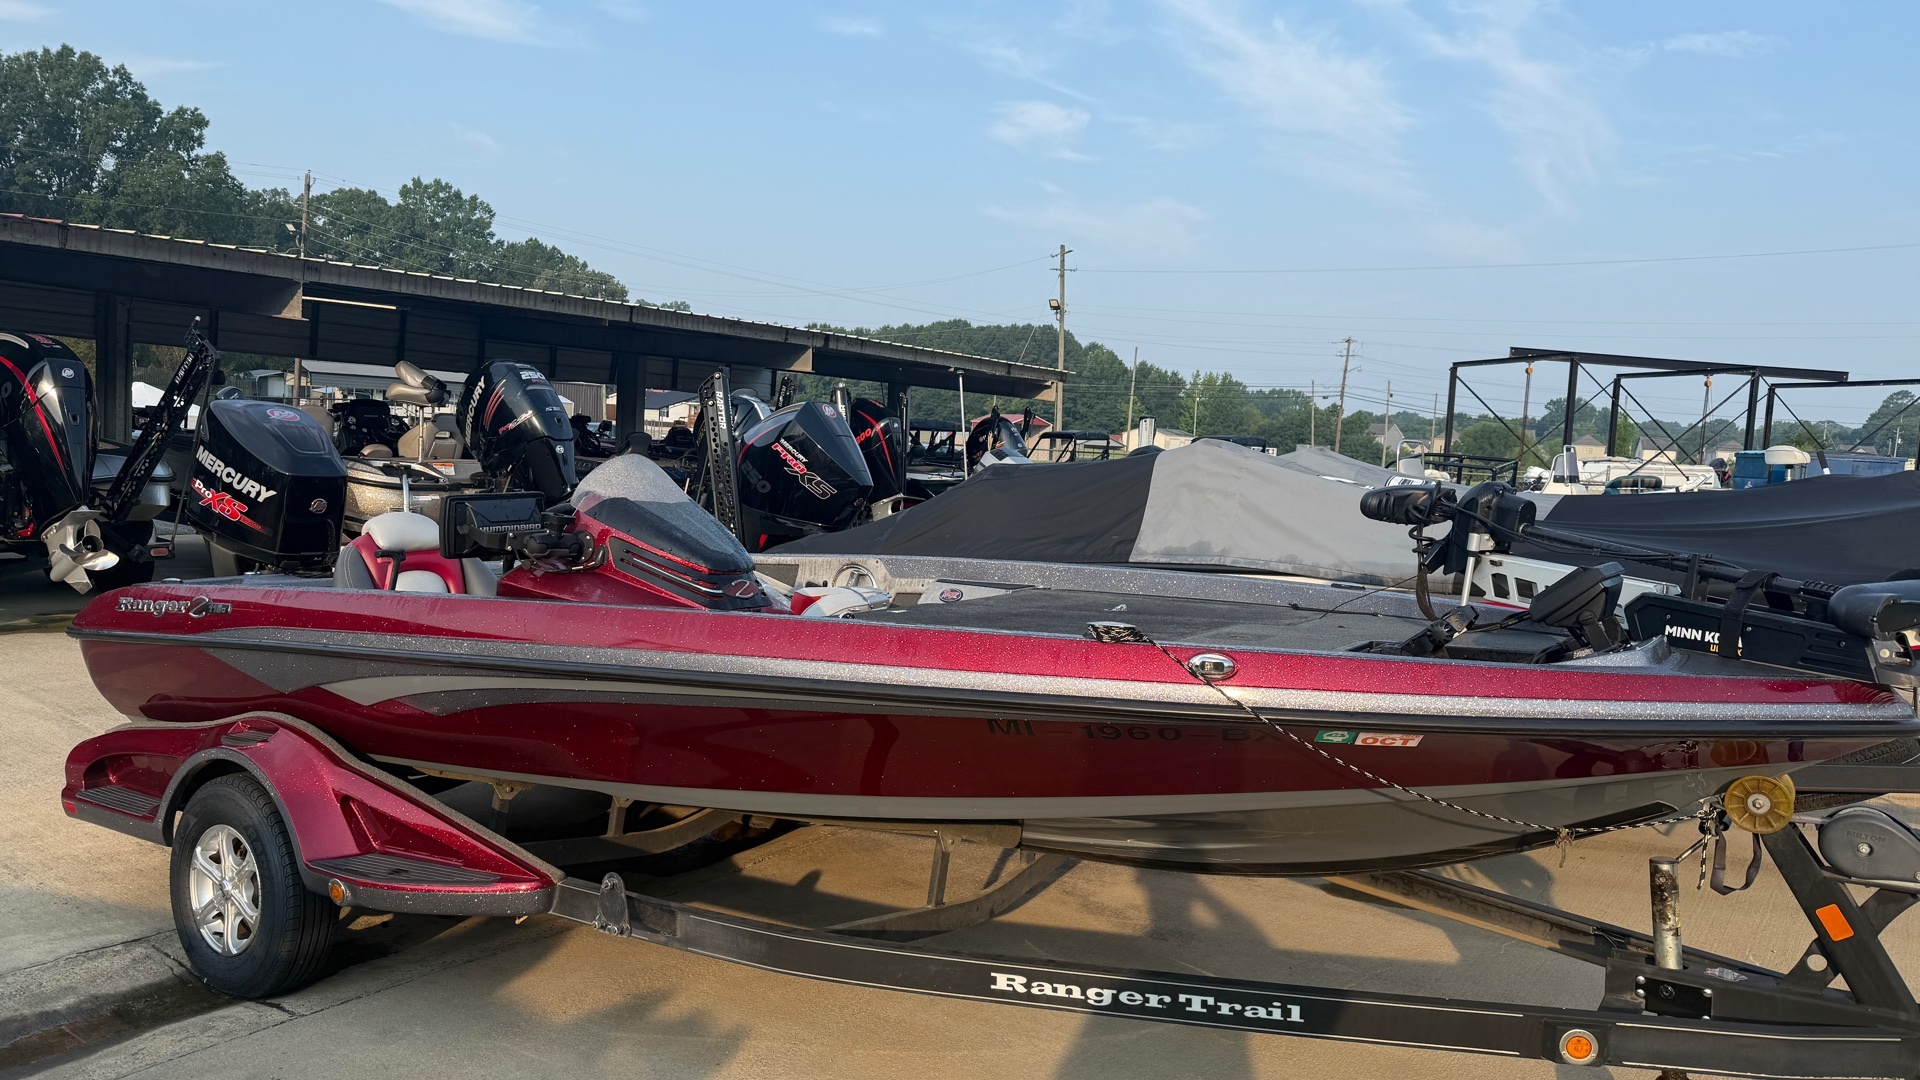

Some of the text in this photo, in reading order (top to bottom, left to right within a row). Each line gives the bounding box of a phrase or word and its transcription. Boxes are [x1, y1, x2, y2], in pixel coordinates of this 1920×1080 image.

[520, 371, 546, 380] 250
[465, 375, 486, 447] MERCURY
[715, 391, 727, 430] RAPTOR
[781, 438, 808, 462] MERCURY
[196, 444, 277, 503] MERCURY
[741, 460, 772, 494] 250
[783, 467, 838, 500] XS
[194, 479, 248, 521] Pro XS
[480, 523, 542, 533] HUMMINBIRD
[115, 597, 191, 617] Ranger
[1665, 624, 1702, 641] MINN
[986, 718, 1035, 737] MI
[1078, 725, 1183, 741] 1960
[1361, 737, 1415, 746] OCT
[1846, 830, 1887, 843] FULTON
[990, 972, 1305, 1023] Ranger Trail
